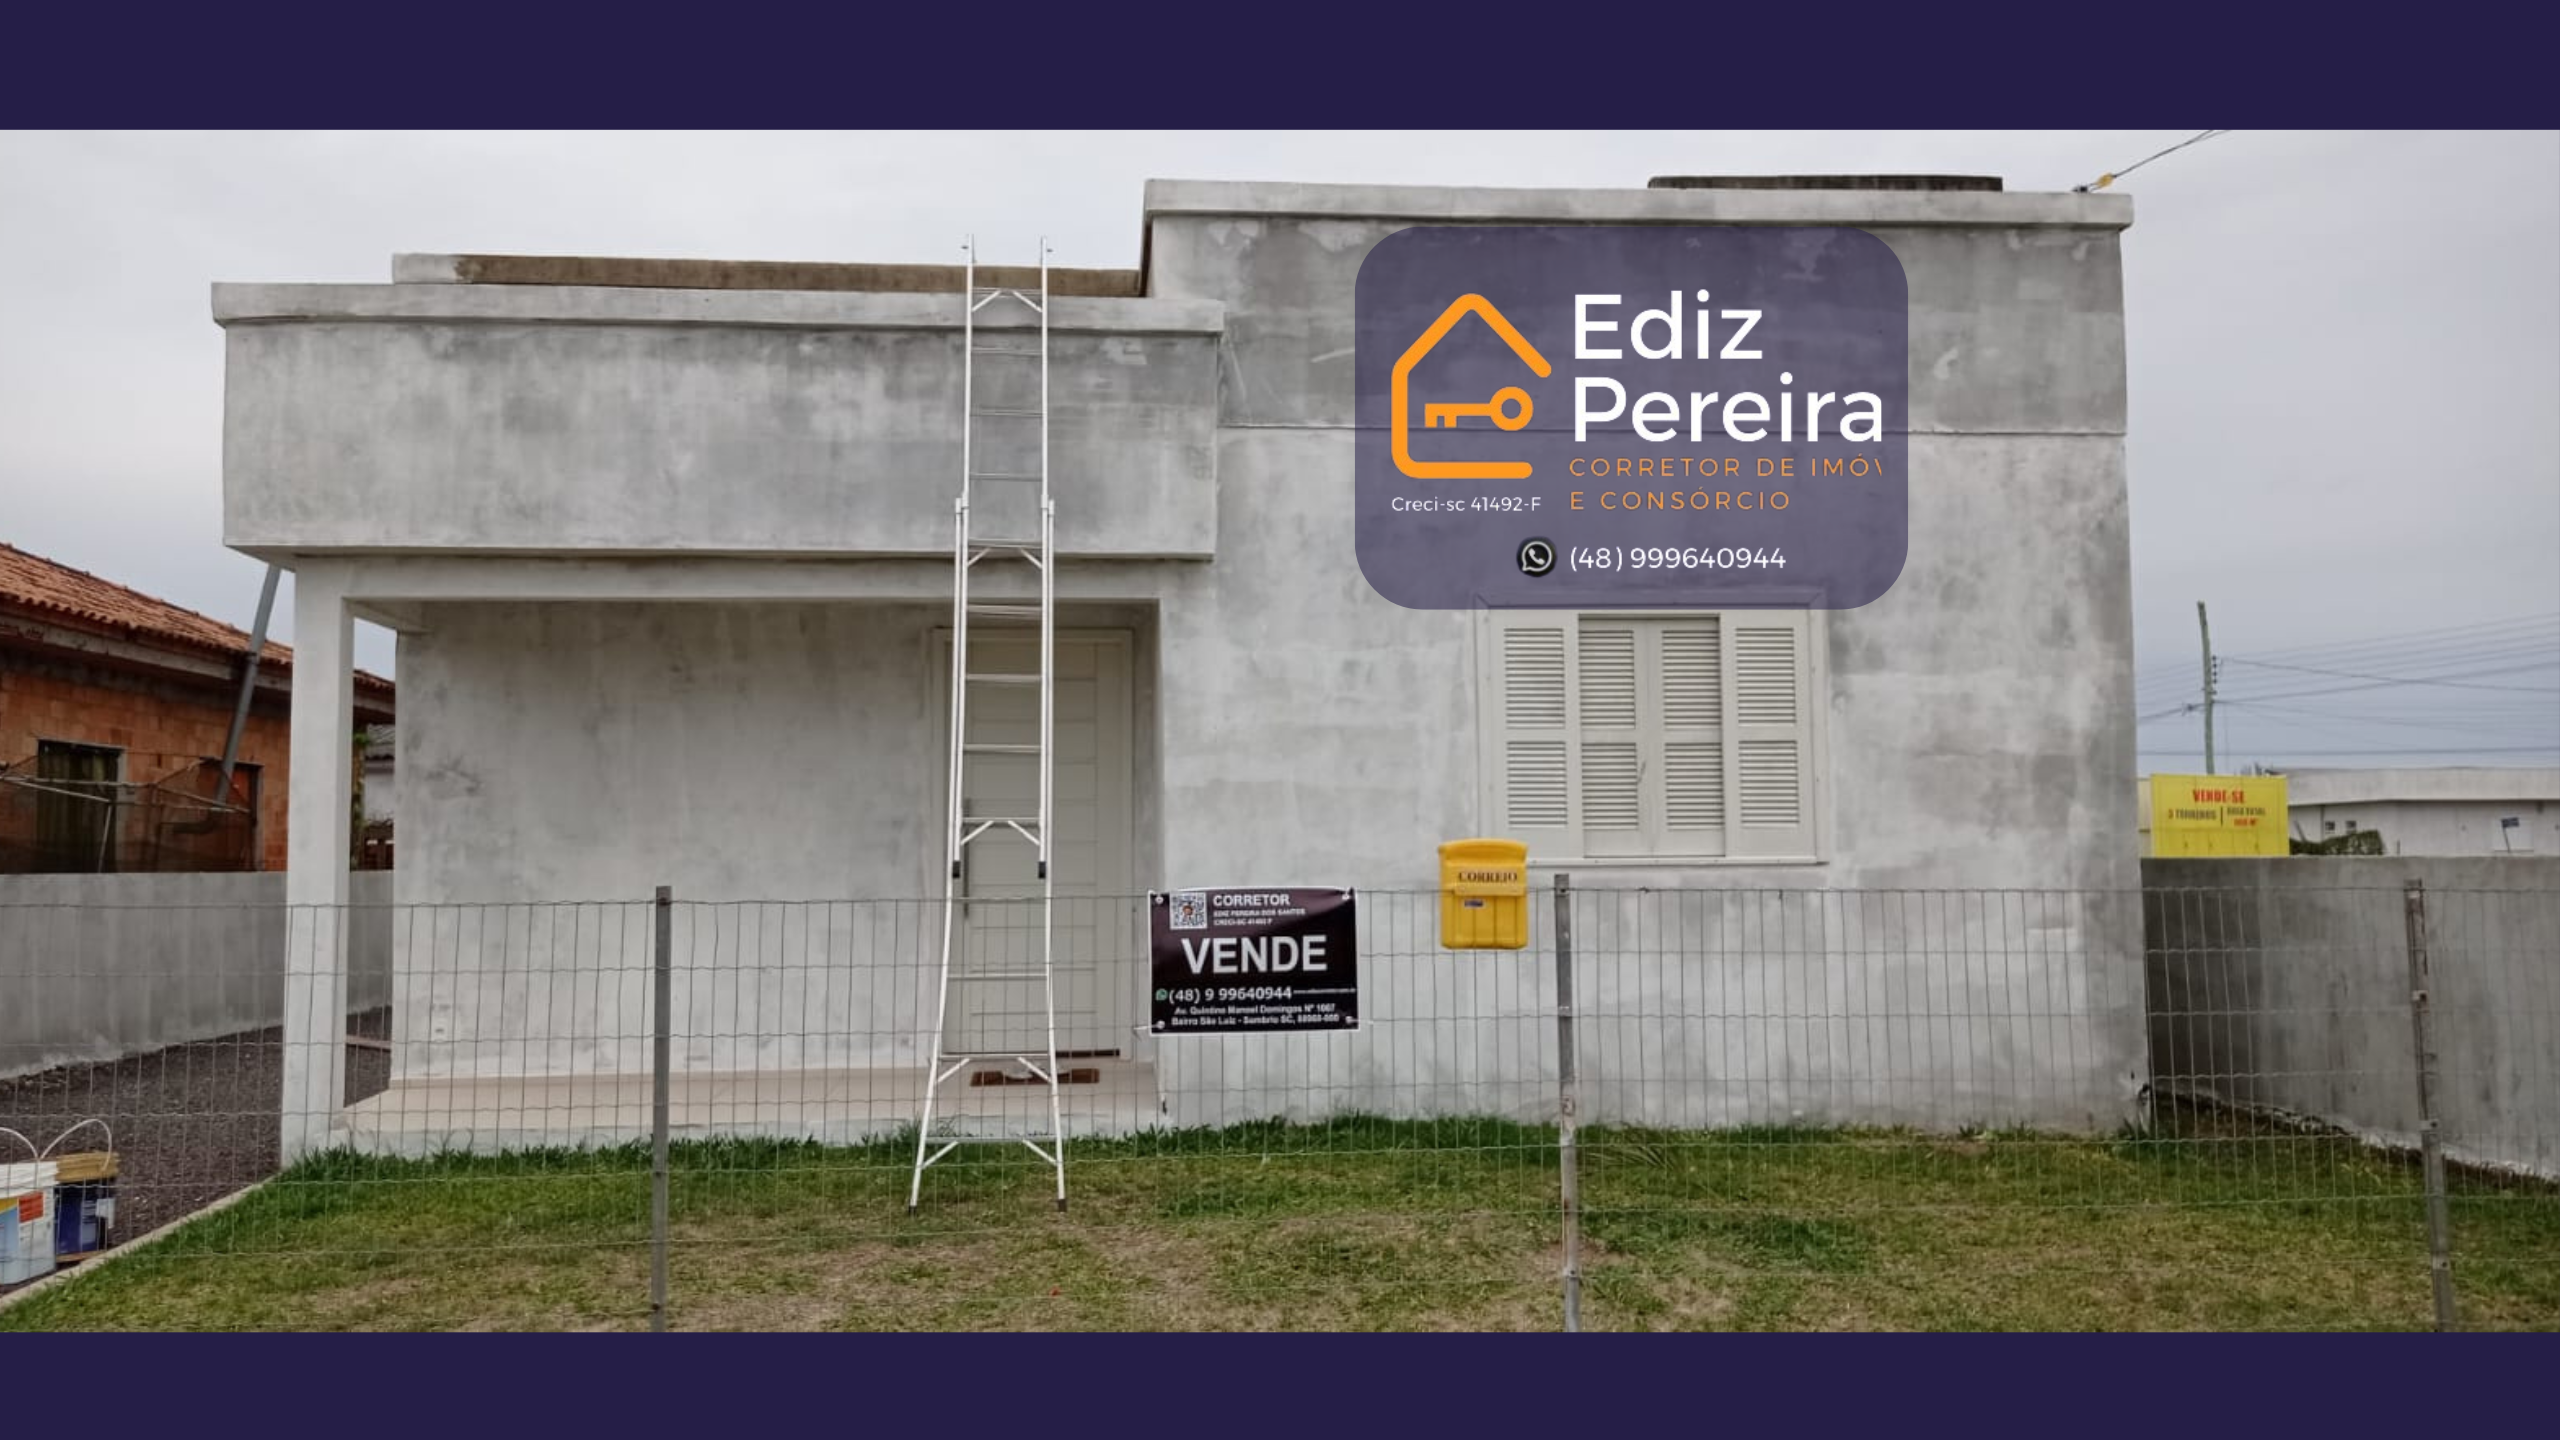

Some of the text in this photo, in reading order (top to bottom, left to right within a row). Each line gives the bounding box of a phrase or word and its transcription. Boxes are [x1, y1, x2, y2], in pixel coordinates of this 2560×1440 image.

[1212, 893, 1291, 907] CORRETOR
[1181, 934, 1329, 975] VENDE
[1168, 988, 1200, 1004] (48)
[1204, 987, 1215, 1001] 9
[1218, 986, 1293, 1001] 99640944
